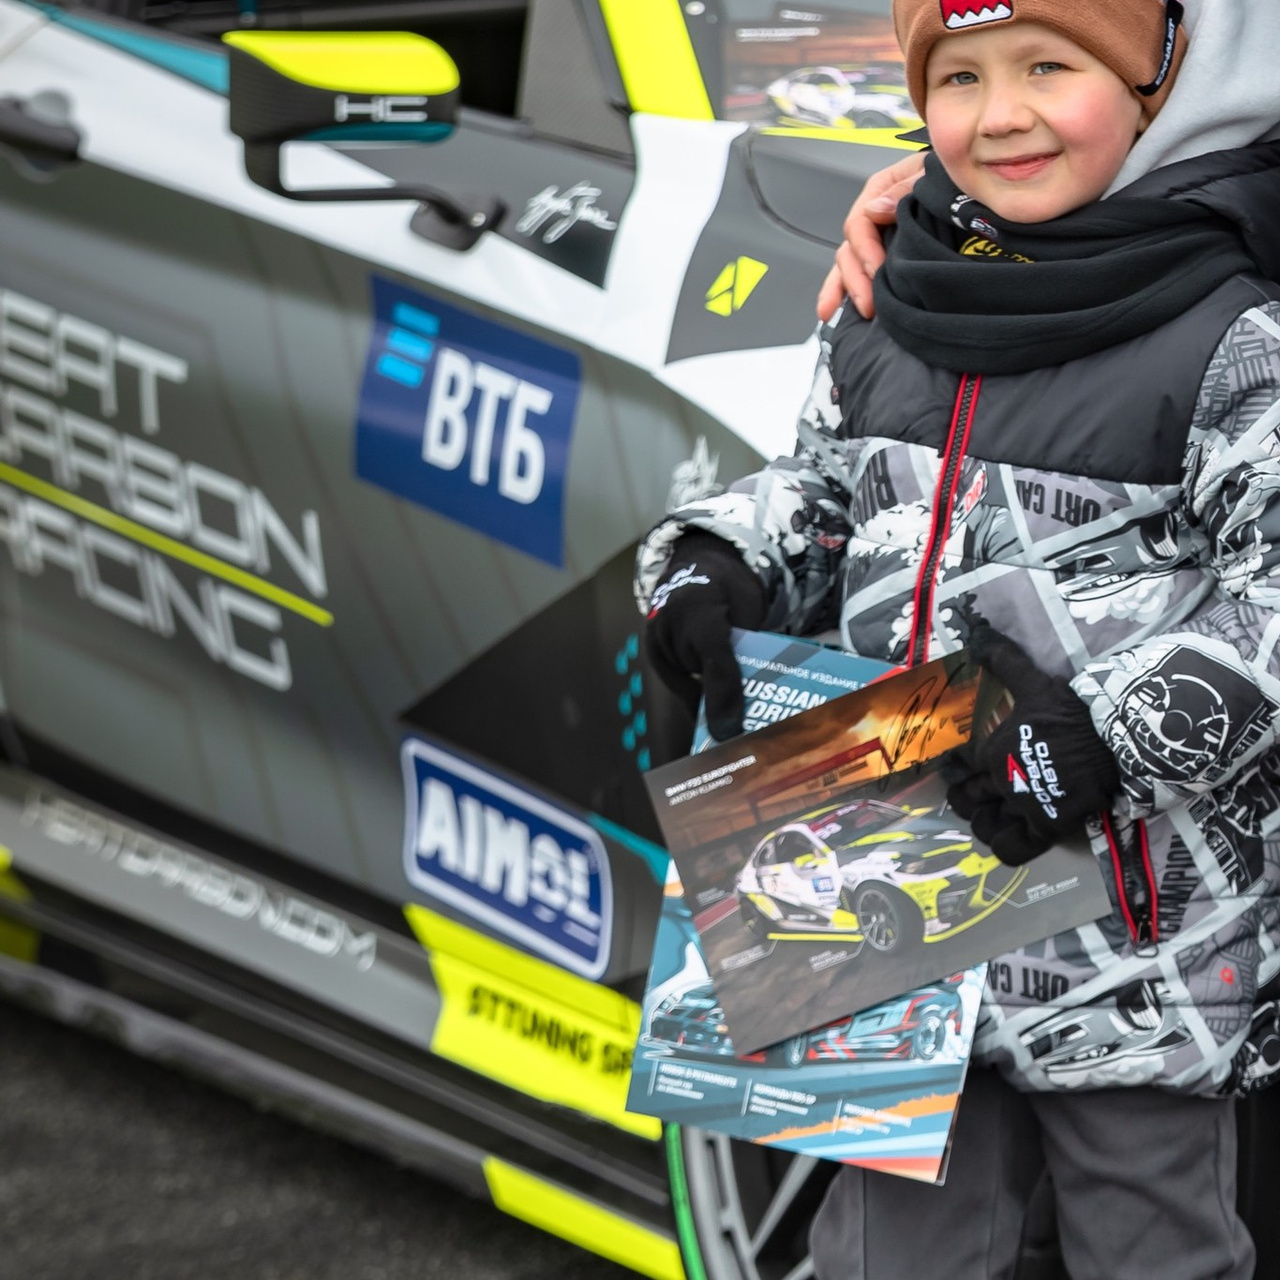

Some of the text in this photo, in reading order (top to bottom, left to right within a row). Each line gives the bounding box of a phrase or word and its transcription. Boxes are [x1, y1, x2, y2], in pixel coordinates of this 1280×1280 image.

[334, 94, 427, 123] HC
[0, 287, 189, 437] EAT
[421, 347, 554, 506] ВТБ
[0, 385, 329, 600] ARBON
[1050, 488, 1102, 528] ORT
[0, 480, 293, 692] ACING
[735, 653, 811, 679] ФИЦИАЛЬНОЕ
[742, 677, 828, 711] USSIAN
[1019, 968, 1069, 1002] ORT
